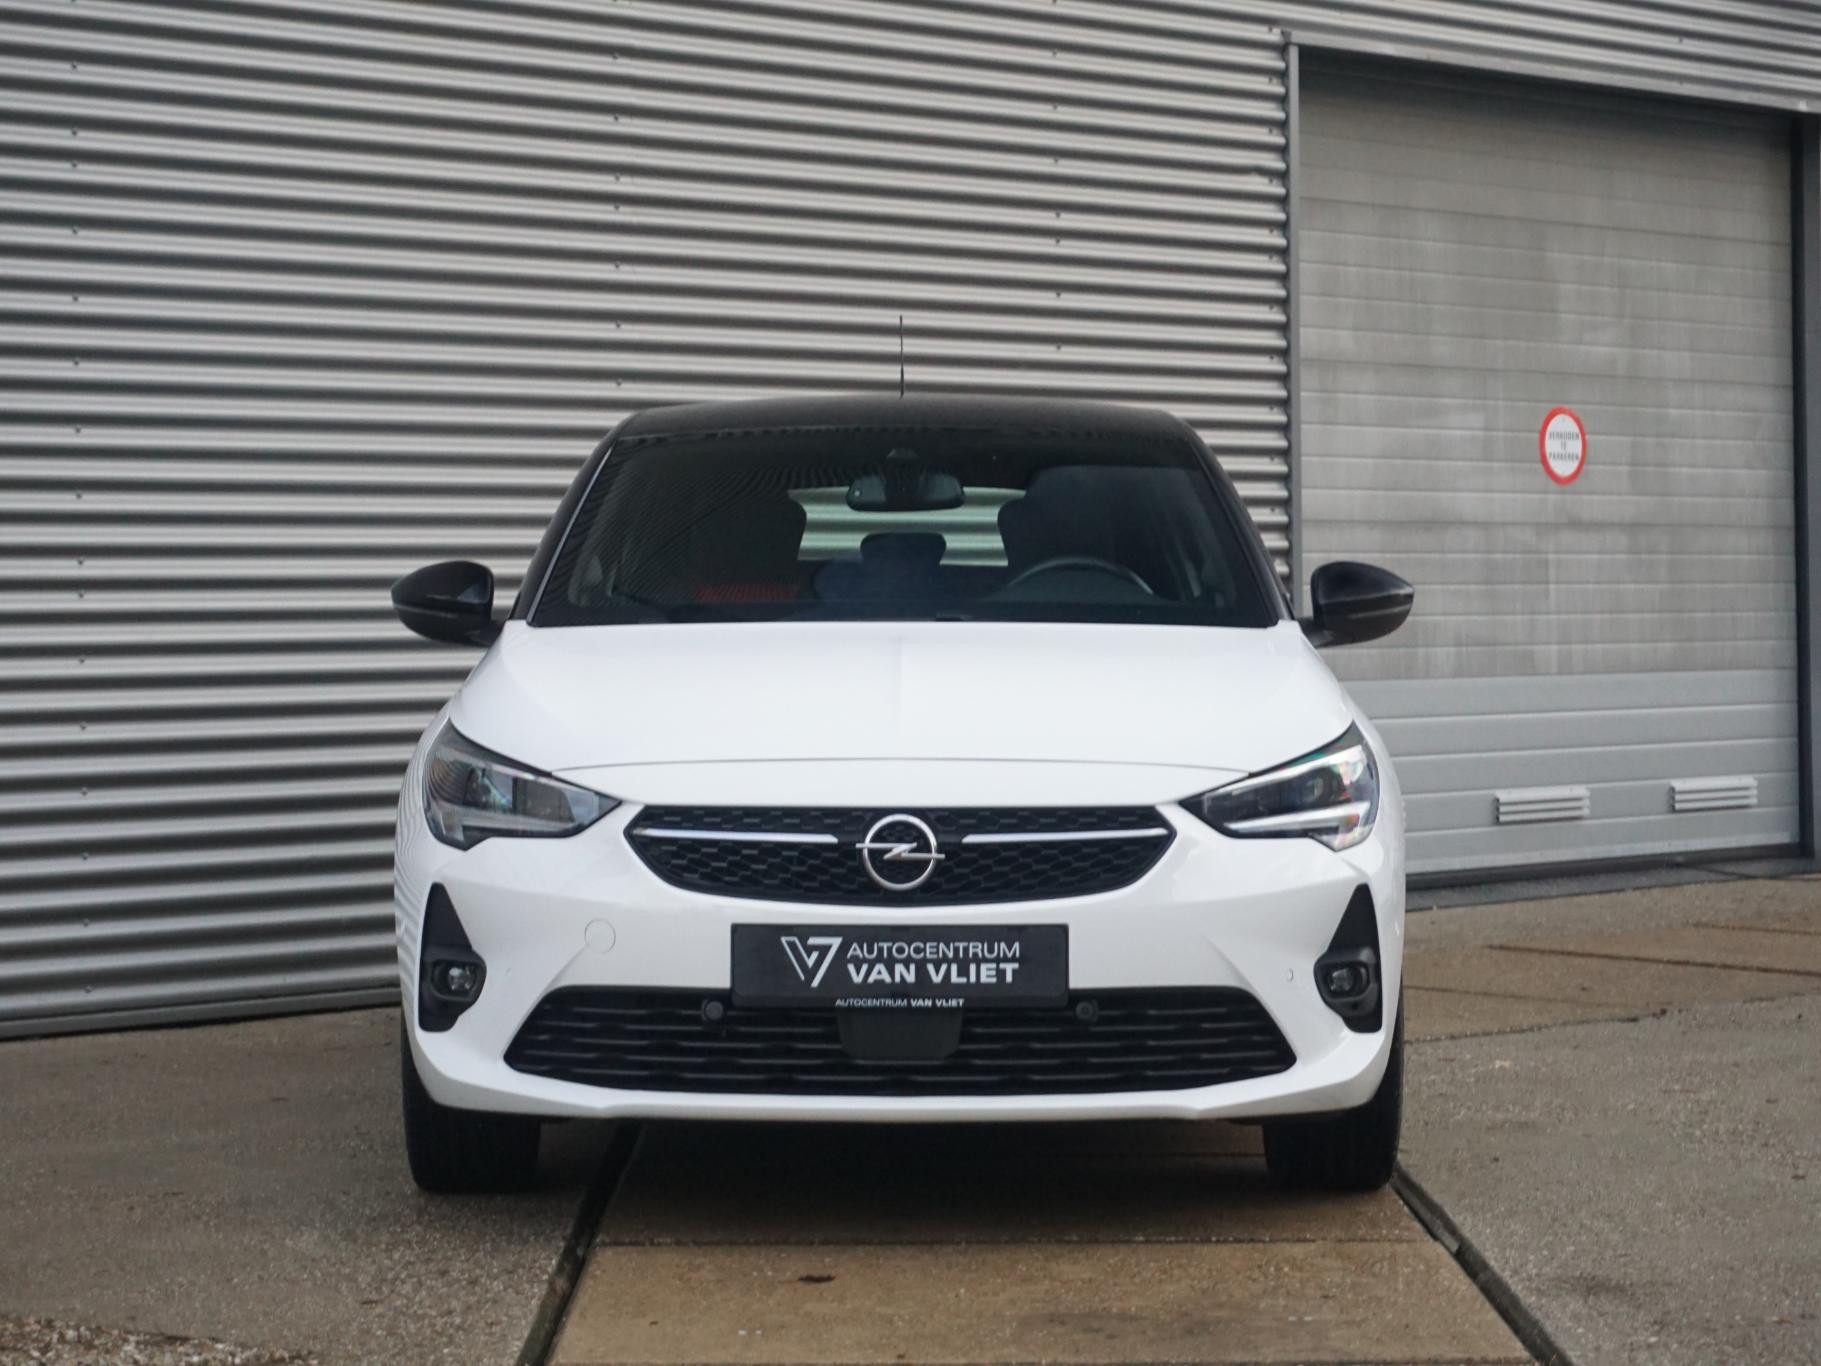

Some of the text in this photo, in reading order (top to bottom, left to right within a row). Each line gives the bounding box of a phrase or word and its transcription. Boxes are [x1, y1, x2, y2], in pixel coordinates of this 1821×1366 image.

[847, 942, 1019, 959] AUTOCENTRUM
[847, 963, 1019, 984] VAN VLIET
[835, 998, 964, 1008] AUTOCENTRUM VAN VLIET
